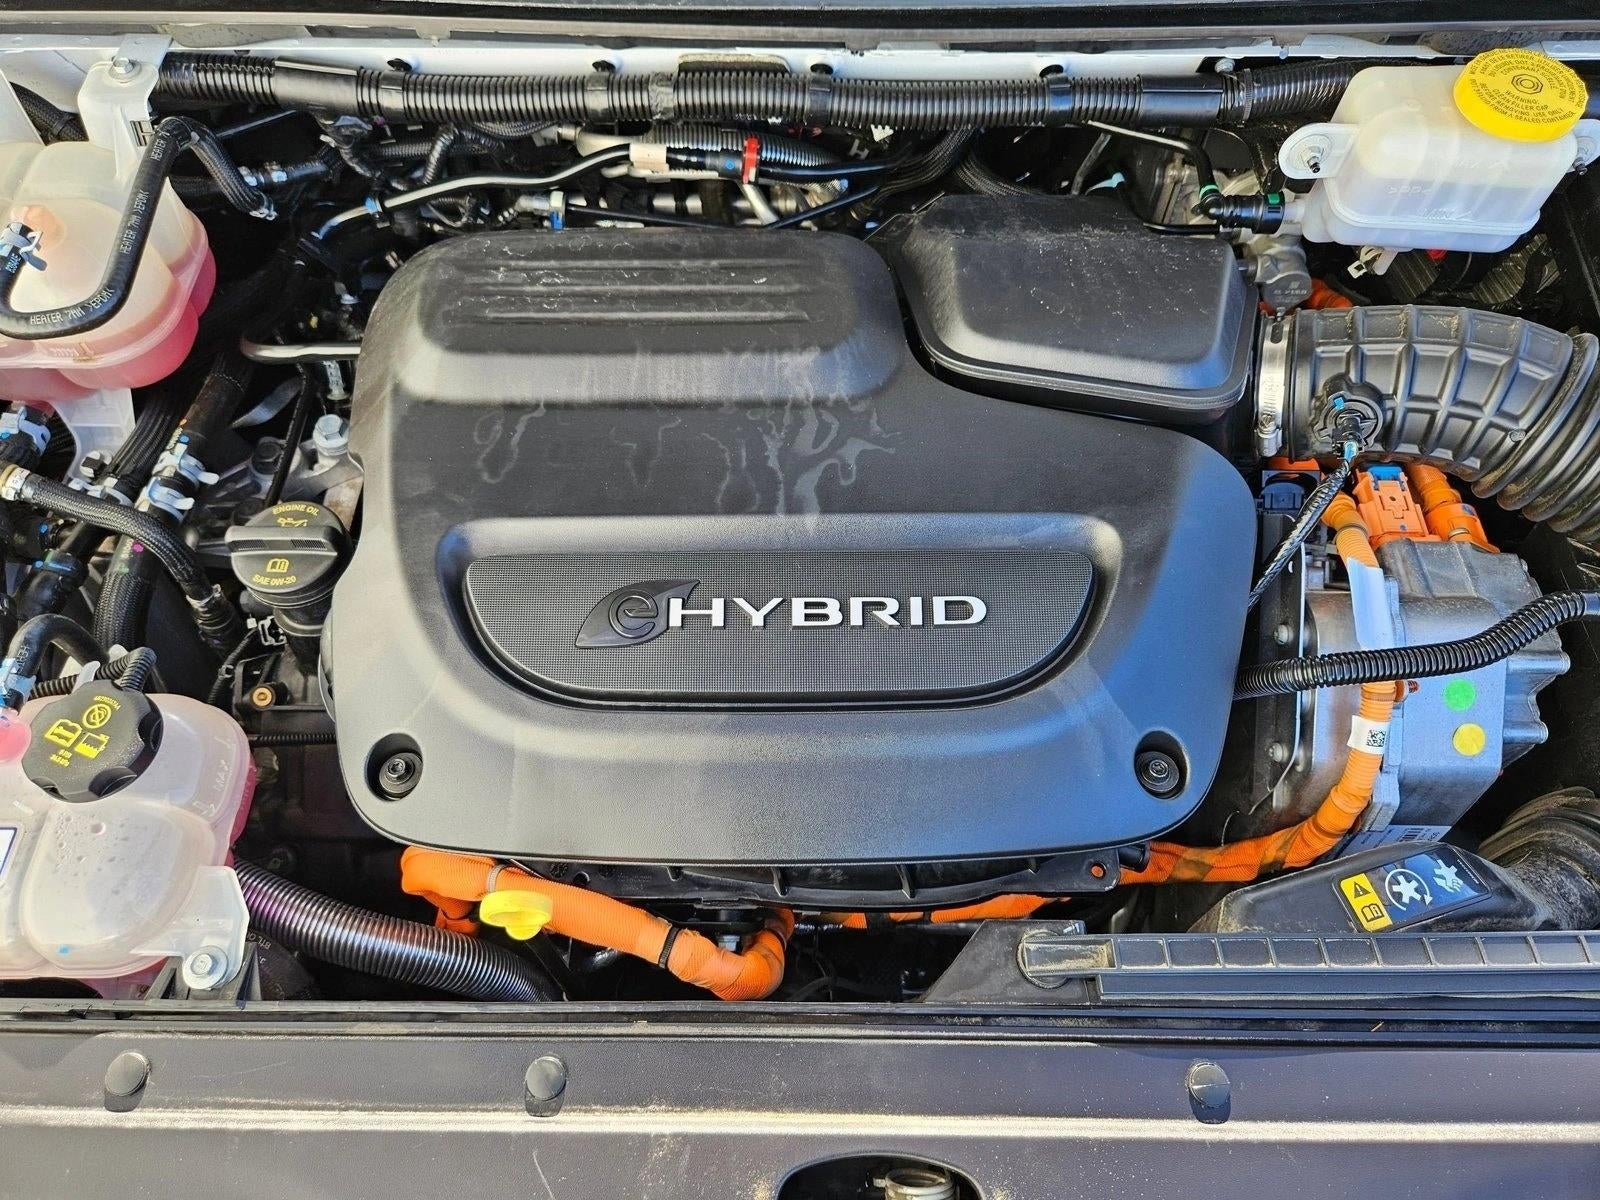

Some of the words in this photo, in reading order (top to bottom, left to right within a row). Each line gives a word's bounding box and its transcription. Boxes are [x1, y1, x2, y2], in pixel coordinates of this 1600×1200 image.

[1491, 88, 1512, 104] CLEAN
[1509, 99, 1534, 111] FILLER
[1534, 103, 1551, 111] CAP
[1487, 102, 1508, 116] FROM
[120, 230, 137, 254] HEATER
[30, 312, 63, 325] HEATER
[272, 504, 307, 515] ENGINE
[306, 506, 320, 516] OIL
[252, 574, 270, 585] SAE
[270, 575, 297, 586] 0W-20
